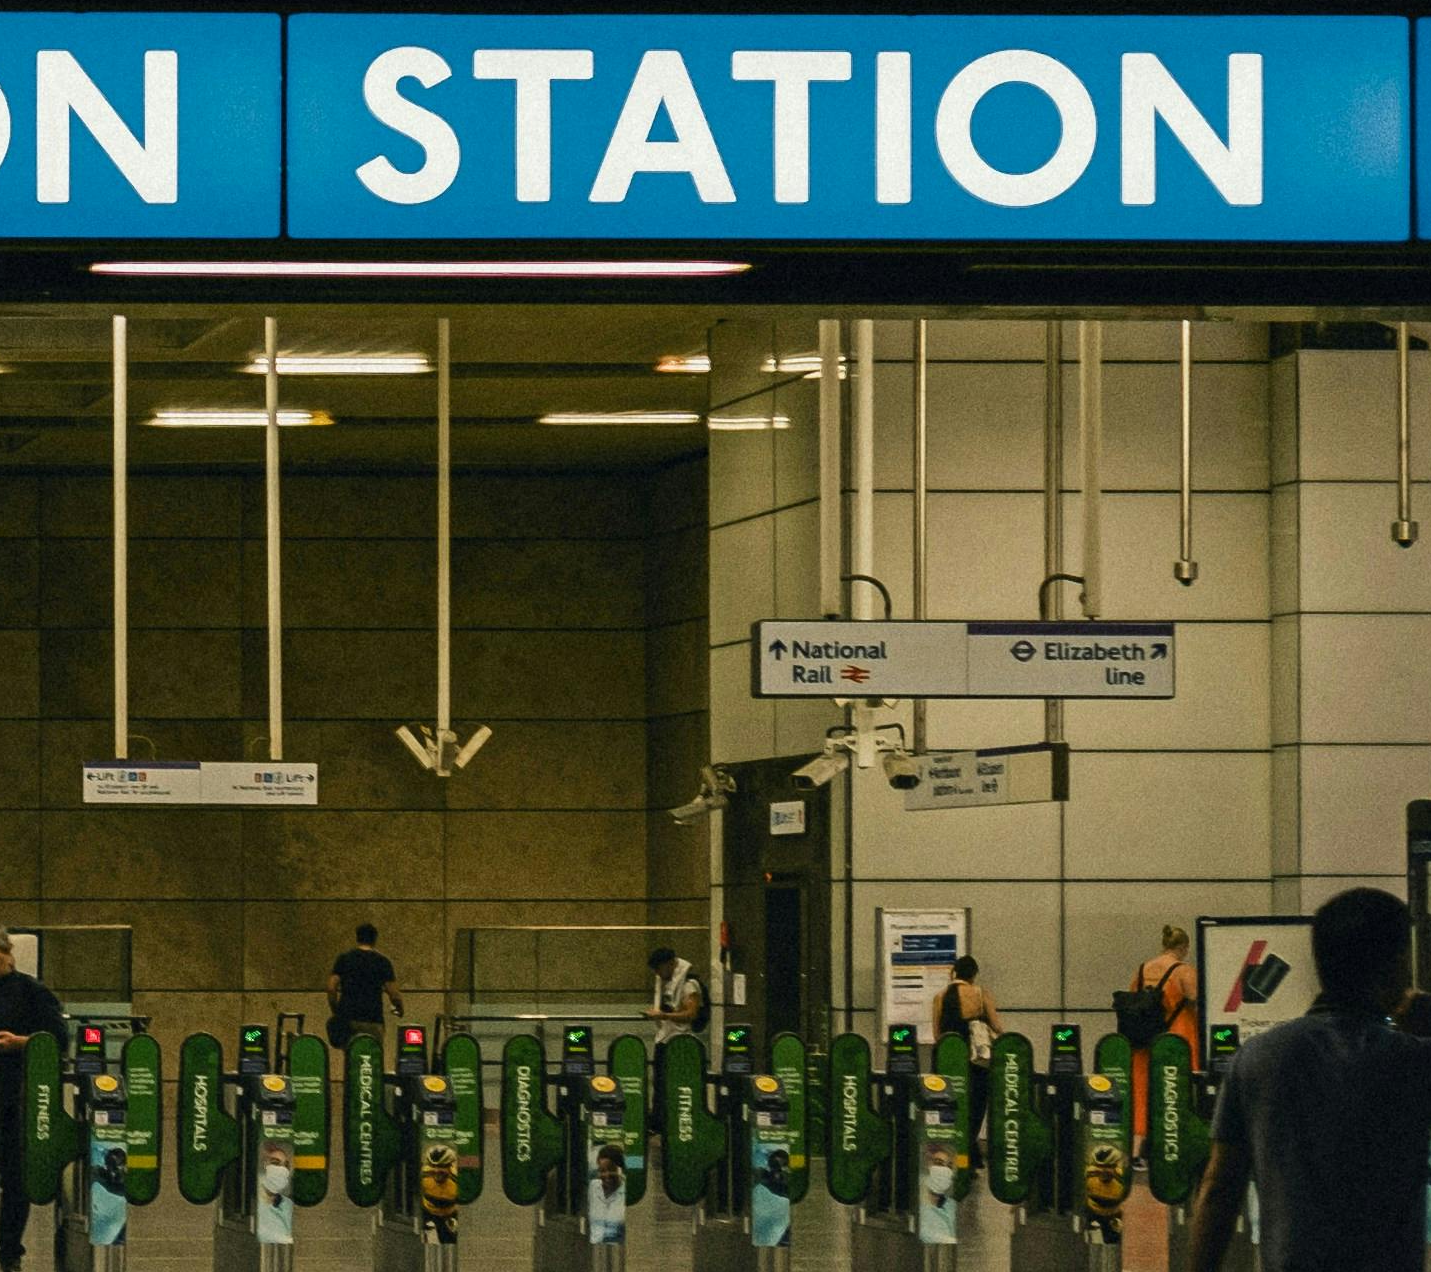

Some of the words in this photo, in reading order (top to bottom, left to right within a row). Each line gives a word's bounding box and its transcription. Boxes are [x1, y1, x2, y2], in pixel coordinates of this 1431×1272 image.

[356, 47, 1262, 206] STATION
[793, 640, 888, 660] National
[793, 664, 833, 684] Rail
[1045, 642, 1146, 662] Elizabeth
[1106, 667, 1146, 686] line
[97, 772, 114, 781] Lift
[285, 773, 303, 783] Lift
[36, 1084, 50, 1141] FITNESS
[193, 1074, 208, 1152] HOSPITALS
[358, 1053, 373, 1119] MEDICAL
[516, 1065, 532, 1163] DIAGNOSTICS
[678, 1086, 693, 1143] FITNESS
[843, 1074, 858, 1152] HOSPITALS
[1004, 1052, 1019, 1116] MEDICAL
[1163, 1065, 1179, 1162] DIAGNOSTICS
[358, 1121, 373, 1186] CENTRES
[1004, 1119, 1019, 1183] CENTRES
